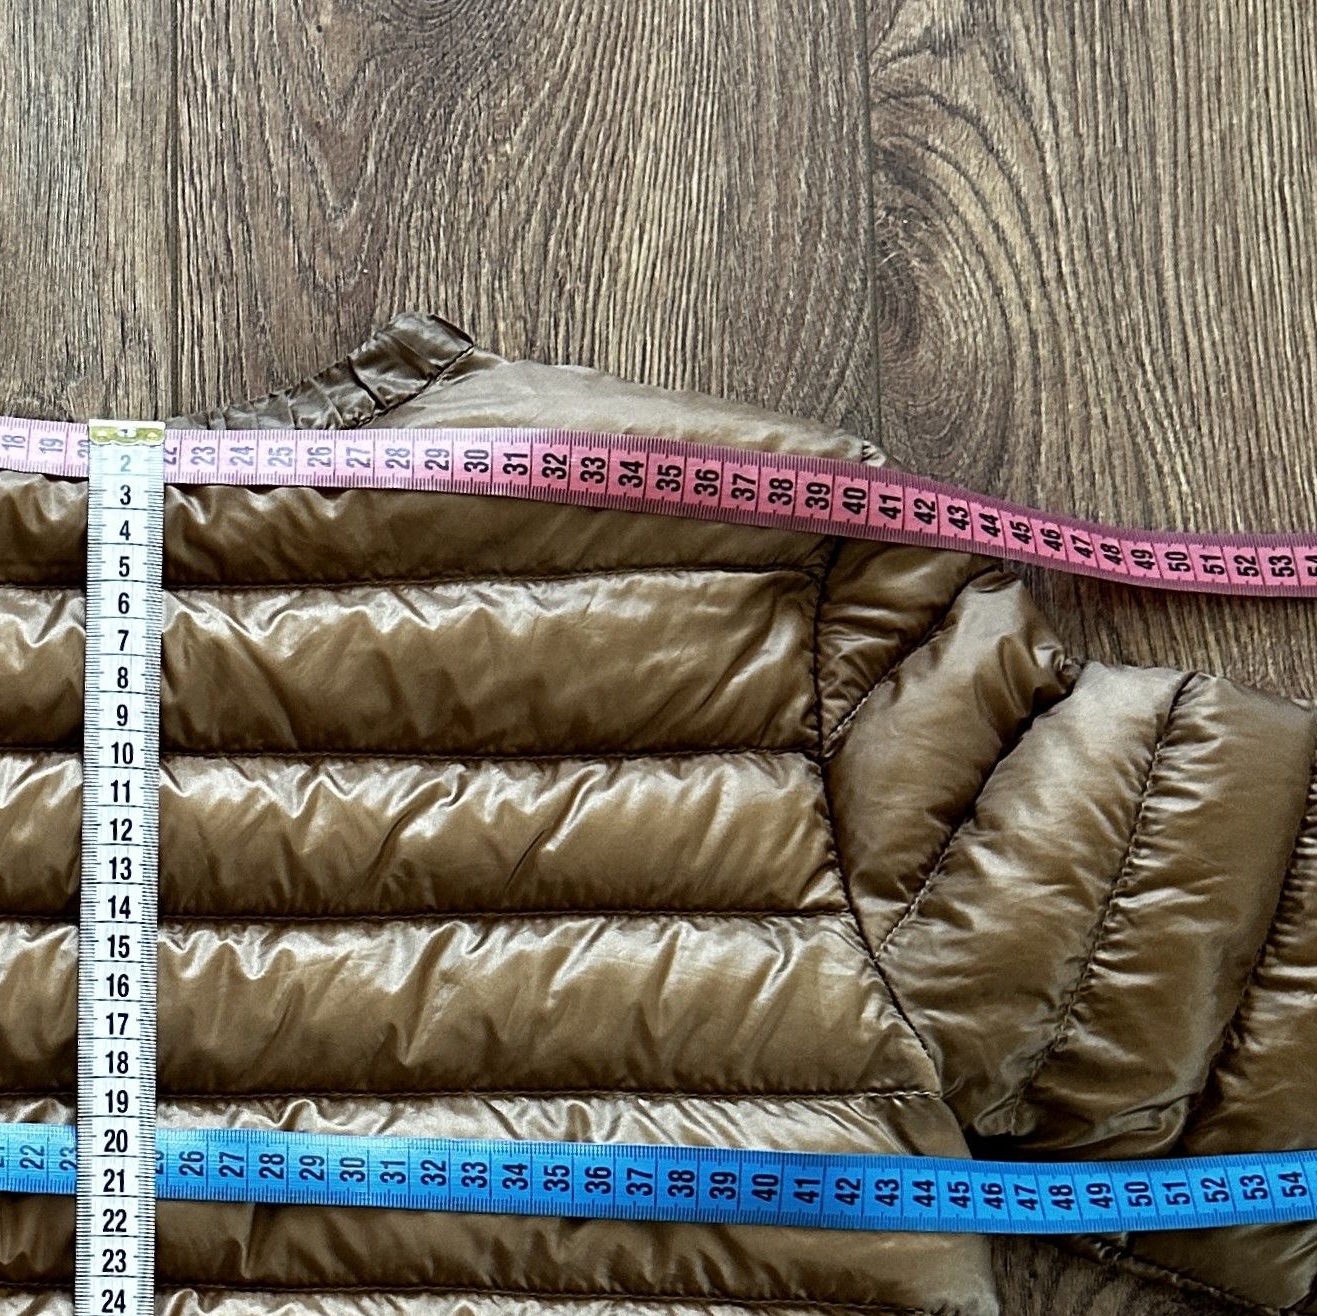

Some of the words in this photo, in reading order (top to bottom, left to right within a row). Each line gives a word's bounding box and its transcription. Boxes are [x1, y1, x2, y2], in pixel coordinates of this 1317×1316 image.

[119, 453, 132, 473] 2
[463, 449, 490, 474] 30
[501, 452, 529, 477] 31
[541, 452, 568, 481] 32
[579, 456, 607, 485] 33
[617, 460, 645, 489] 34
[654, 464, 683, 493] 35
[692, 468, 720, 498] 36
[730, 473, 757, 502] 37
[119, 484, 132, 506] 3
[767, 477, 794, 507] 38
[804, 481, 831, 511] 39
[841, 486, 867, 516] 40
[877, 493, 902, 521] 41
[913, 497, 937, 526] 42
[946, 504, 971, 531] 43
[119, 519, 132, 541] 4
[978, 512, 1001, 538] 44
[1011, 520, 1033, 545] 45
[1040, 528, 1064, 552] 46
[1071, 534, 1094, 559] 47
[118, 555, 131, 578] 5
[1099, 542, 1124, 566] 48
[1130, 548, 1156, 571] 49
[1164, 551, 1191, 573] 50
[1202, 553, 1225, 576] 51
[1232, 554, 1261, 578] 52
[1267, 554, 1296, 578] 53
[117, 591, 131, 615] 6
[117, 629, 130, 652] 7
[117, 665, 129, 690] 8
[116, 703, 129, 727] 9
[110, 741, 134, 765] 10
[110, 779, 131, 804] 11
[109, 817, 133, 842] 12
[108, 855, 132, 881] 13
[107, 894, 132, 920] 14
[107, 933, 131, 959] 15
[105, 972, 130, 998] 16
[105, 1011, 129, 1036] 17
[105, 1050, 129, 1075] 18
[104, 1089, 129, 1114] 19
[103, 1128, 129, 1153] 20
[19, 1144, 45, 1171] 22
[178, 1150, 205, 1177] 26
[218, 1151, 245, 1179] 27
[258, 1153, 285, 1180] 28
[298, 1155, 325, 1182] 29
[102, 1168, 125, 1193] 21
[420, 1159, 447, 1187] 32
[460, 1161, 488, 1189] 33
[501, 1163, 529, 1191] 34
[543, 1164, 571, 1193] 35
[583, 1166, 612, 1195] 36
[625, 1167, 654, 1197] 37
[667, 1169, 696, 1199] 38
[708, 1171, 738, 1201] 39
[751, 1173, 780, 1203] 40
[793, 1178, 821, 1205] 41
[834, 1177, 861, 1207] 42
[874, 1178, 900, 1207] 43
[911, 1179, 936, 1208] 44
[947, 1181, 971, 1209] 45
[981, 1182, 1005, 1210] 46
[1013, 1183, 1039, 1211] 47
[1048, 1184, 1075, 1211] 48
[1085, 1182, 1114, 1209] 49
[1124, 1181, 1153, 1207] 50
[102, 1208, 127, 1233] 22
[101, 1248, 127, 1273] 23
[101, 1288, 127, 1314] 24
